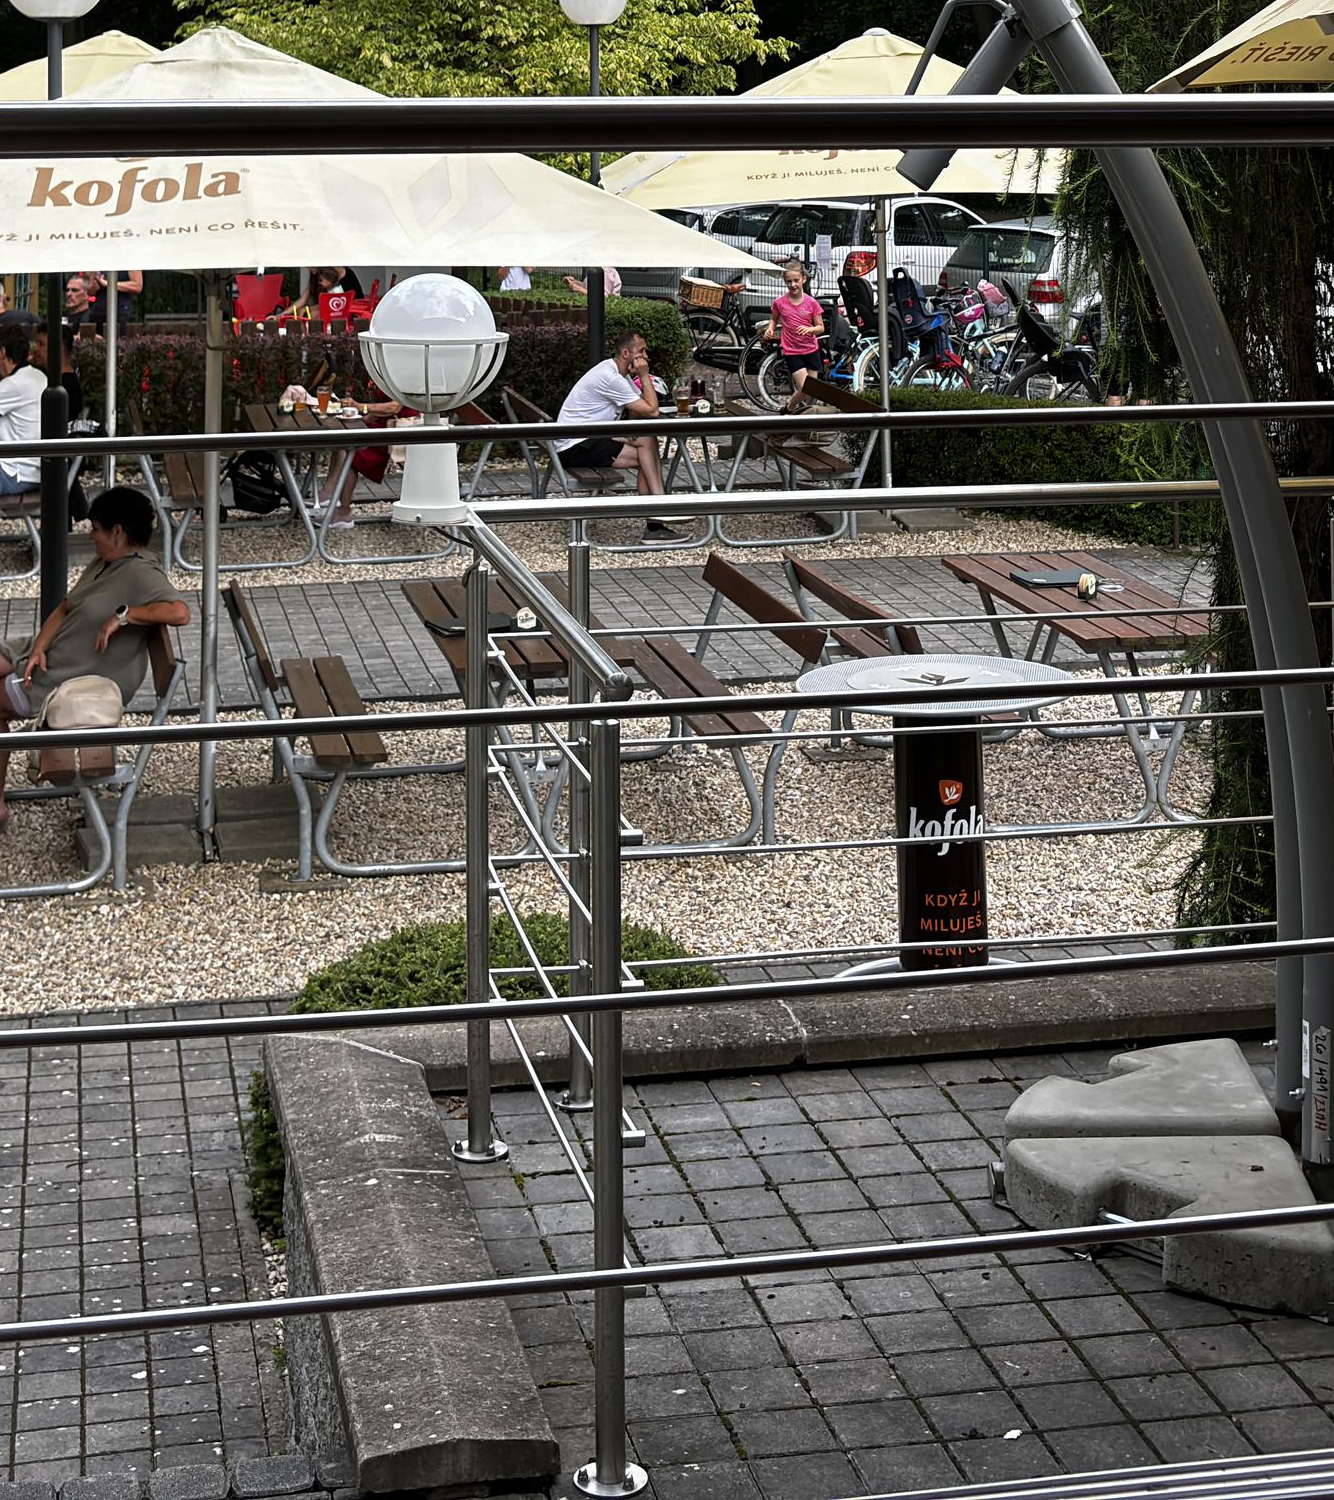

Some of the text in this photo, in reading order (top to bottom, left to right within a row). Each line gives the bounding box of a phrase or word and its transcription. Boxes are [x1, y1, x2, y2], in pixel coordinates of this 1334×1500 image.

[851, 165, 880, 174] NENÍ
[26, 162, 242, 217] kofola
[24, 233, 41, 242] JI
[149, 224, 199, 236] NENÍ
[207, 222, 235, 232] CO
[908, 804, 984, 857] kofola
[925, 888, 981, 907] KDYŽ JI
